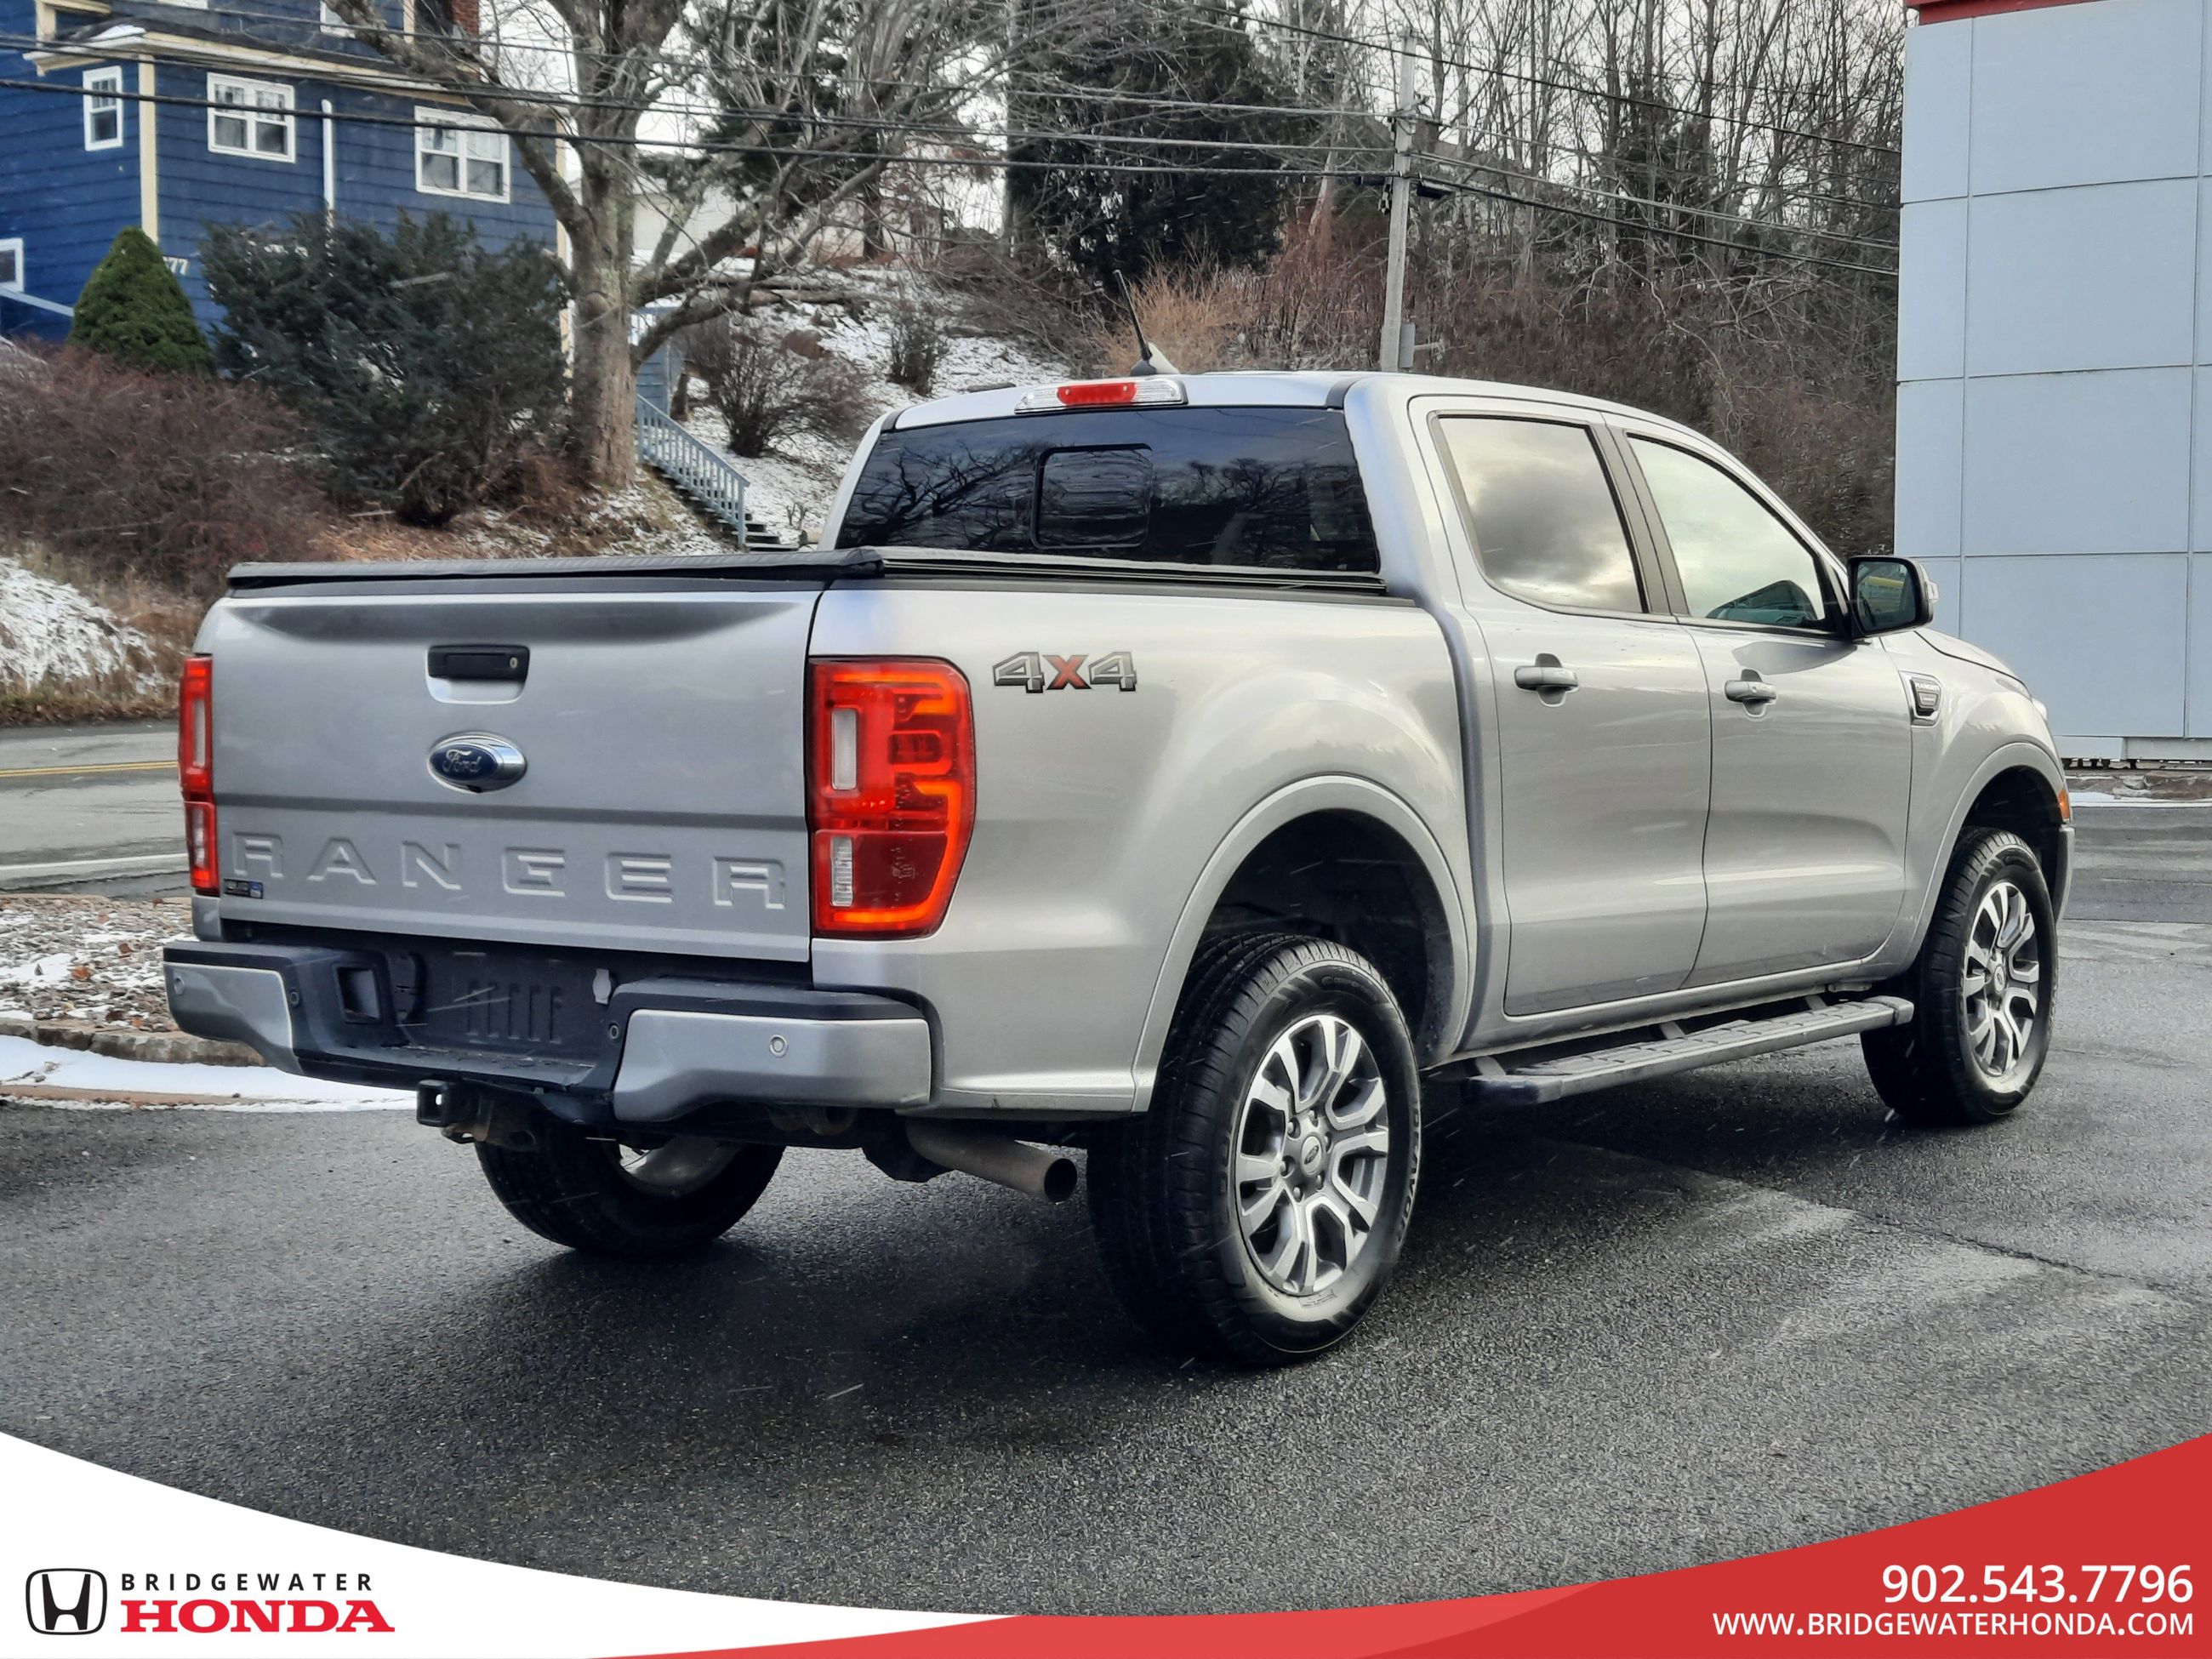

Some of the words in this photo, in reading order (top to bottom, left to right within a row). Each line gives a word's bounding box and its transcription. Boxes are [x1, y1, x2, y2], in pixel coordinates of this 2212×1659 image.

[162, 255, 188, 276] 77
[442, 749, 482, 772] Ford
[232, 830, 786, 910] RANGER
